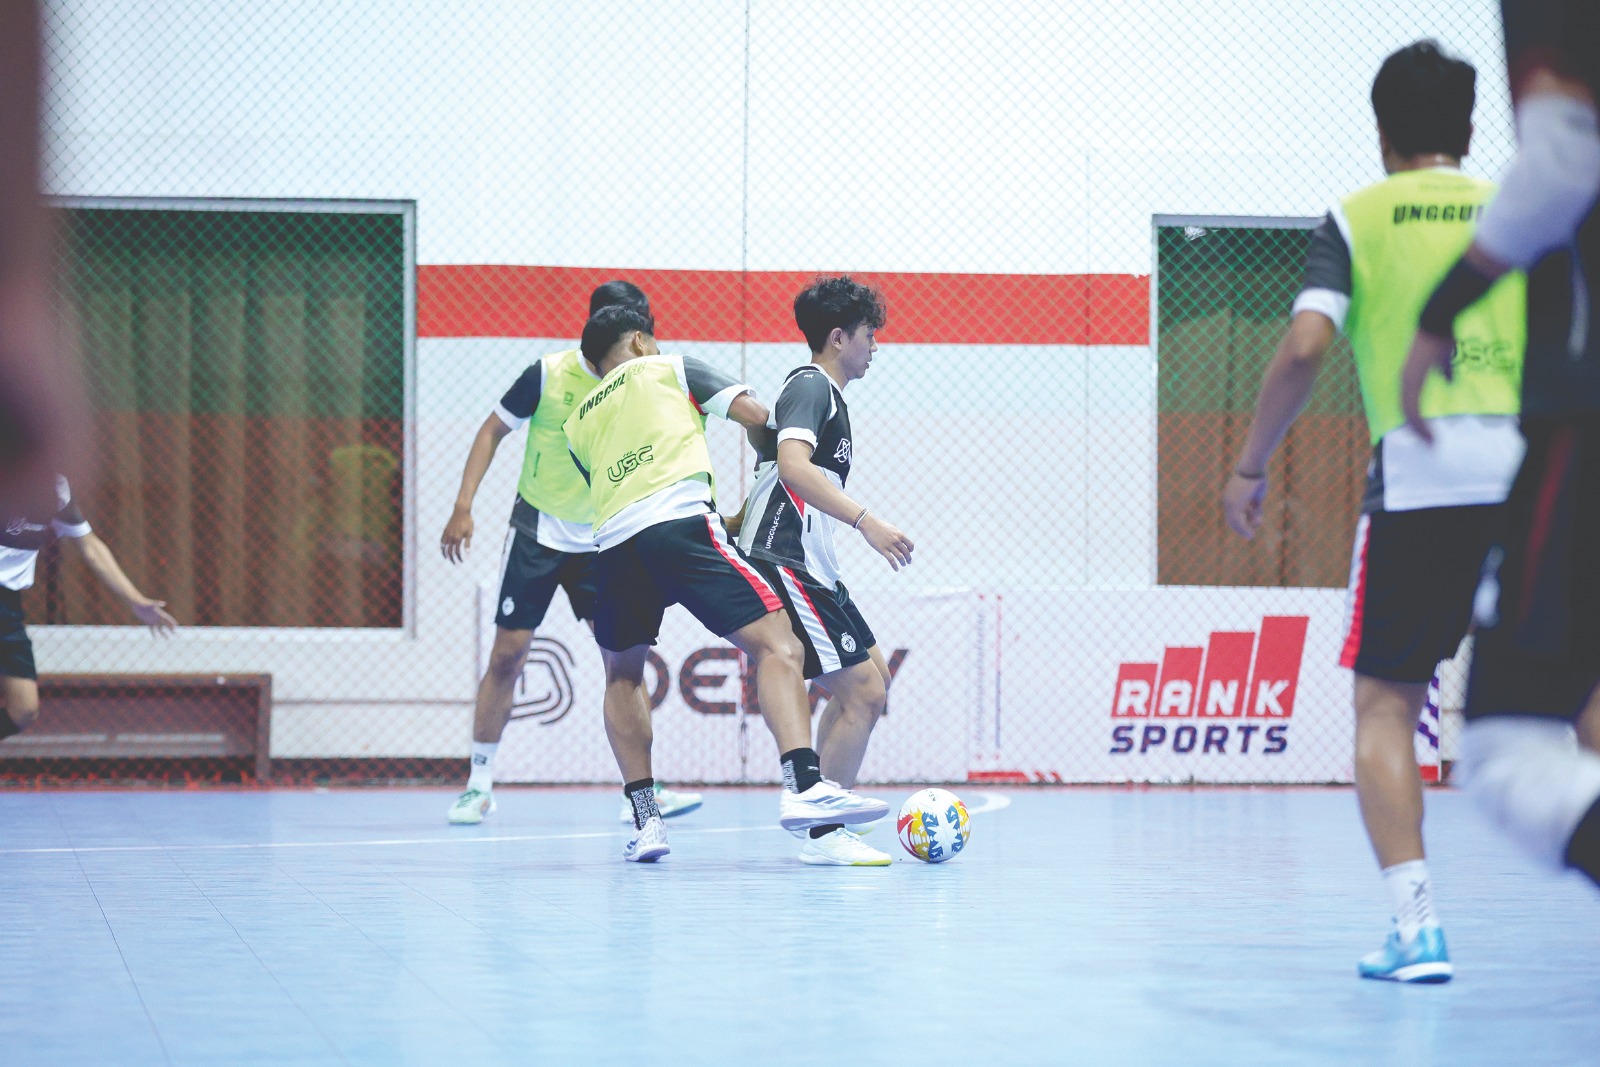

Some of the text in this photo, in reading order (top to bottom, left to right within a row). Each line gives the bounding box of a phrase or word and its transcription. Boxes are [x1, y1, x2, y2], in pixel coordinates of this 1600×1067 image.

[579, 372, 626, 421] UNGGUL
[607, 444, 654, 482] USC
[1116, 679, 1290, 716] RANK
[1109, 725, 1288, 754] SPORTS
